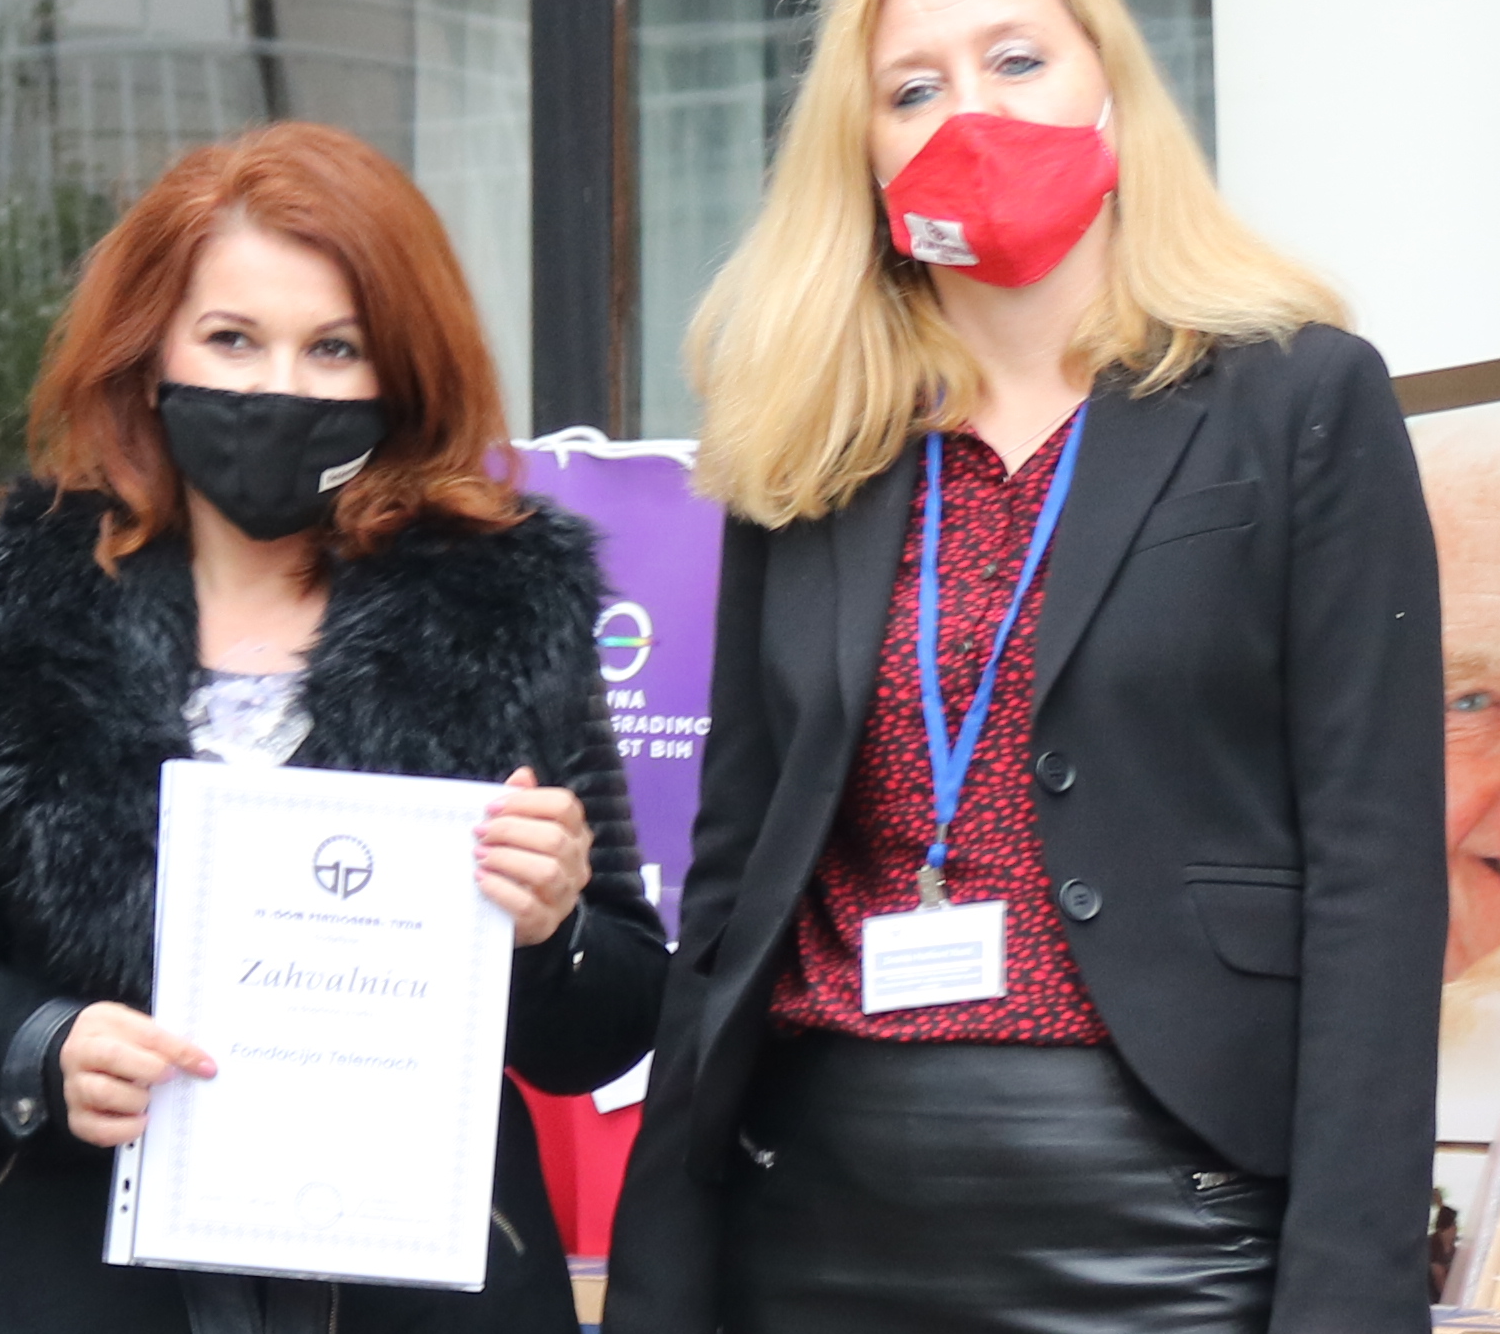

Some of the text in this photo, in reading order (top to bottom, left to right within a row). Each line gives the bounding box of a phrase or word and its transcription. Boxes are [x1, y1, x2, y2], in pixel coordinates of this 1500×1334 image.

[650, 739, 694, 759] BIH
[237, 958, 430, 999] Zahvalnicu
[230, 1042, 419, 1071] Fondacija Telemach
